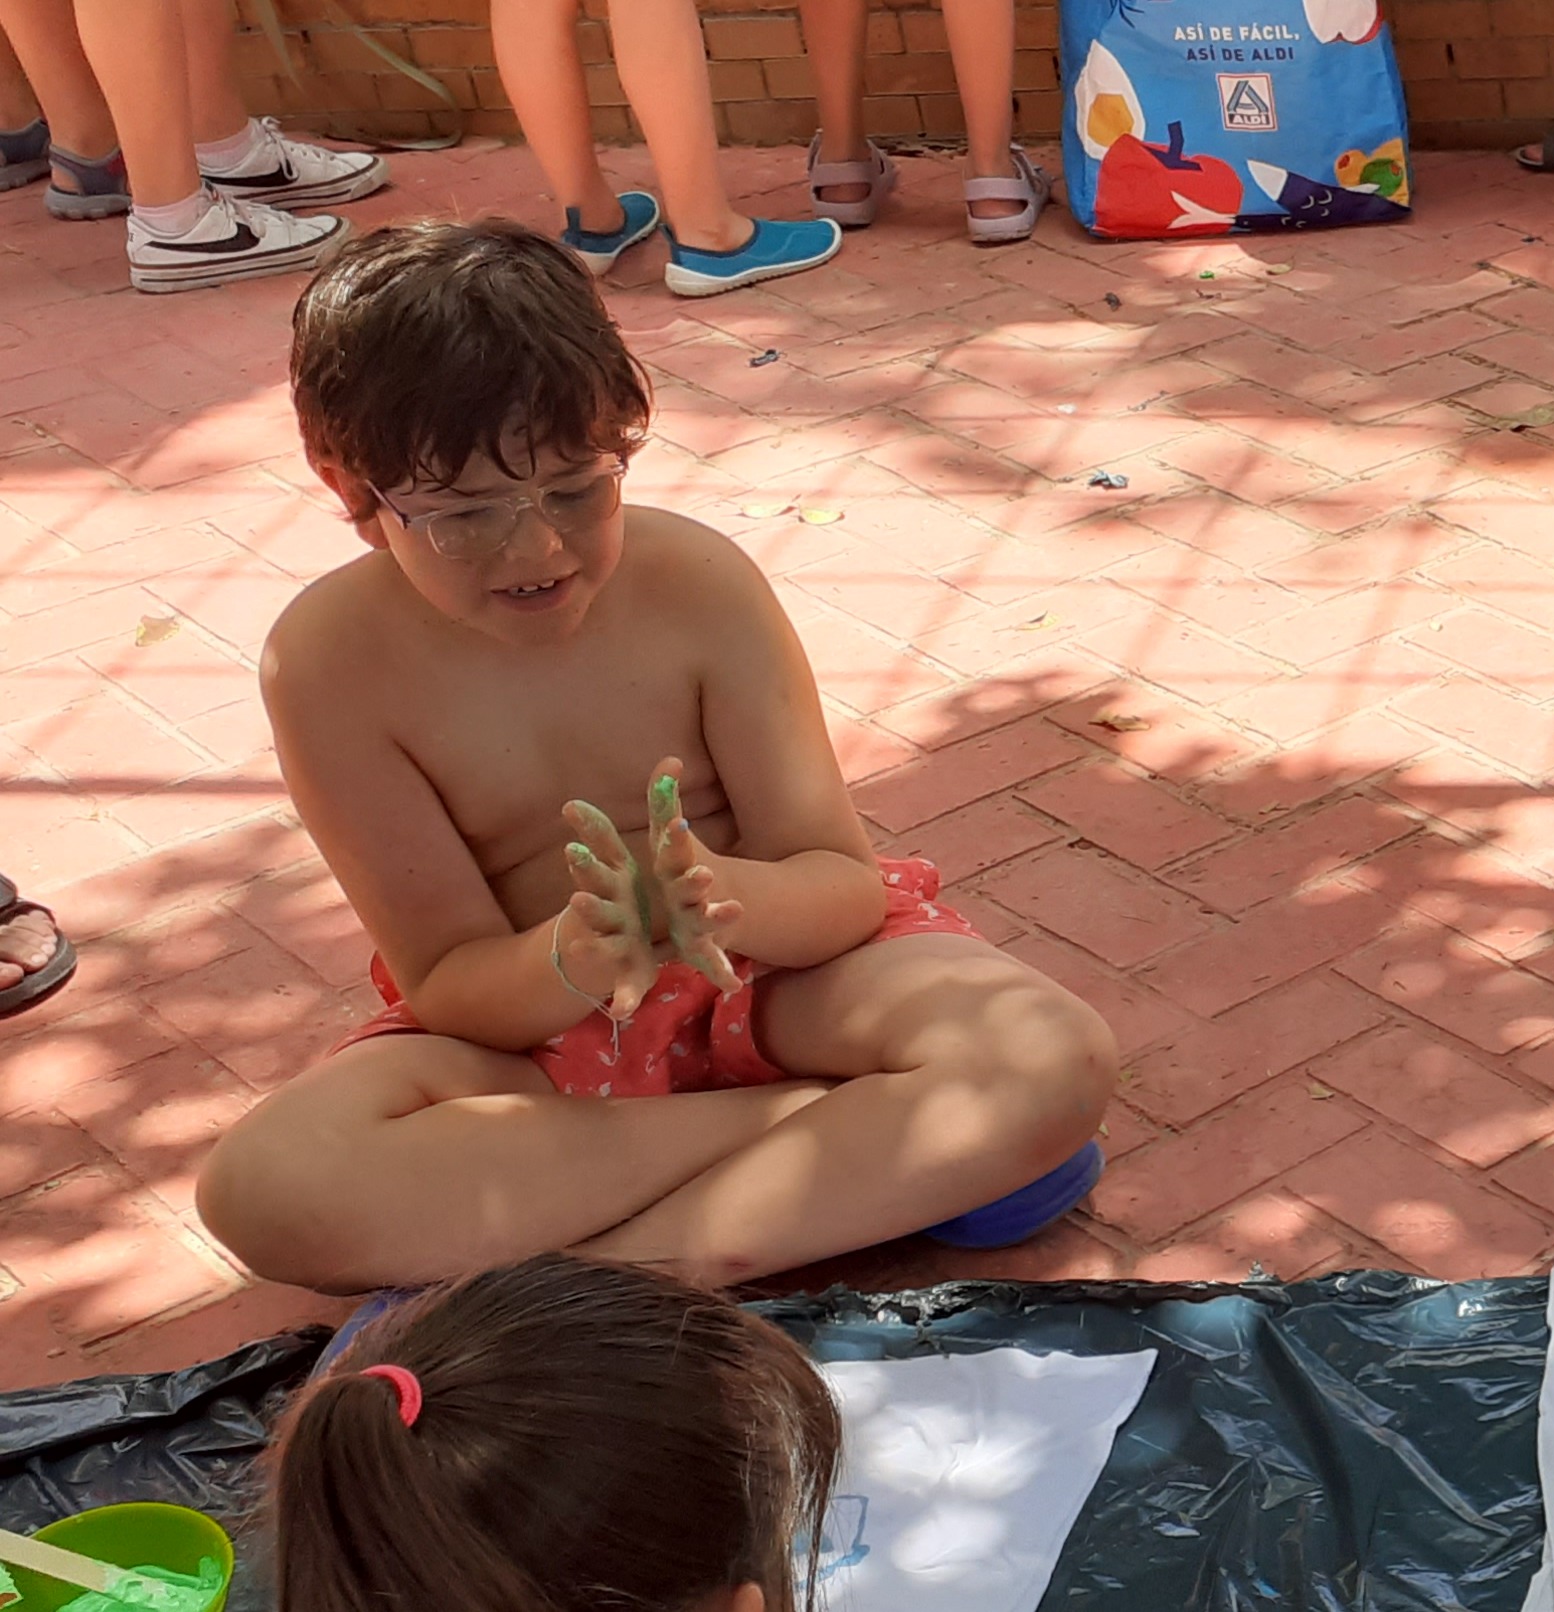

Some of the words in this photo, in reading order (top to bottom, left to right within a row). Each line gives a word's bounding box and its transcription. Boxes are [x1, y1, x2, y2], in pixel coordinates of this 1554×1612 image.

[1174, 23, 1204, 41] ASÍ
[1209, 26, 1233, 41] DE
[1239, 22, 1300, 42] FÁCIL,
[1186, 44, 1216, 61] ASÍ
[1222, 48, 1245, 62] DE
[1252, 46, 1295, 62] ALDI
[1231, 114, 1269, 126] ALDI
